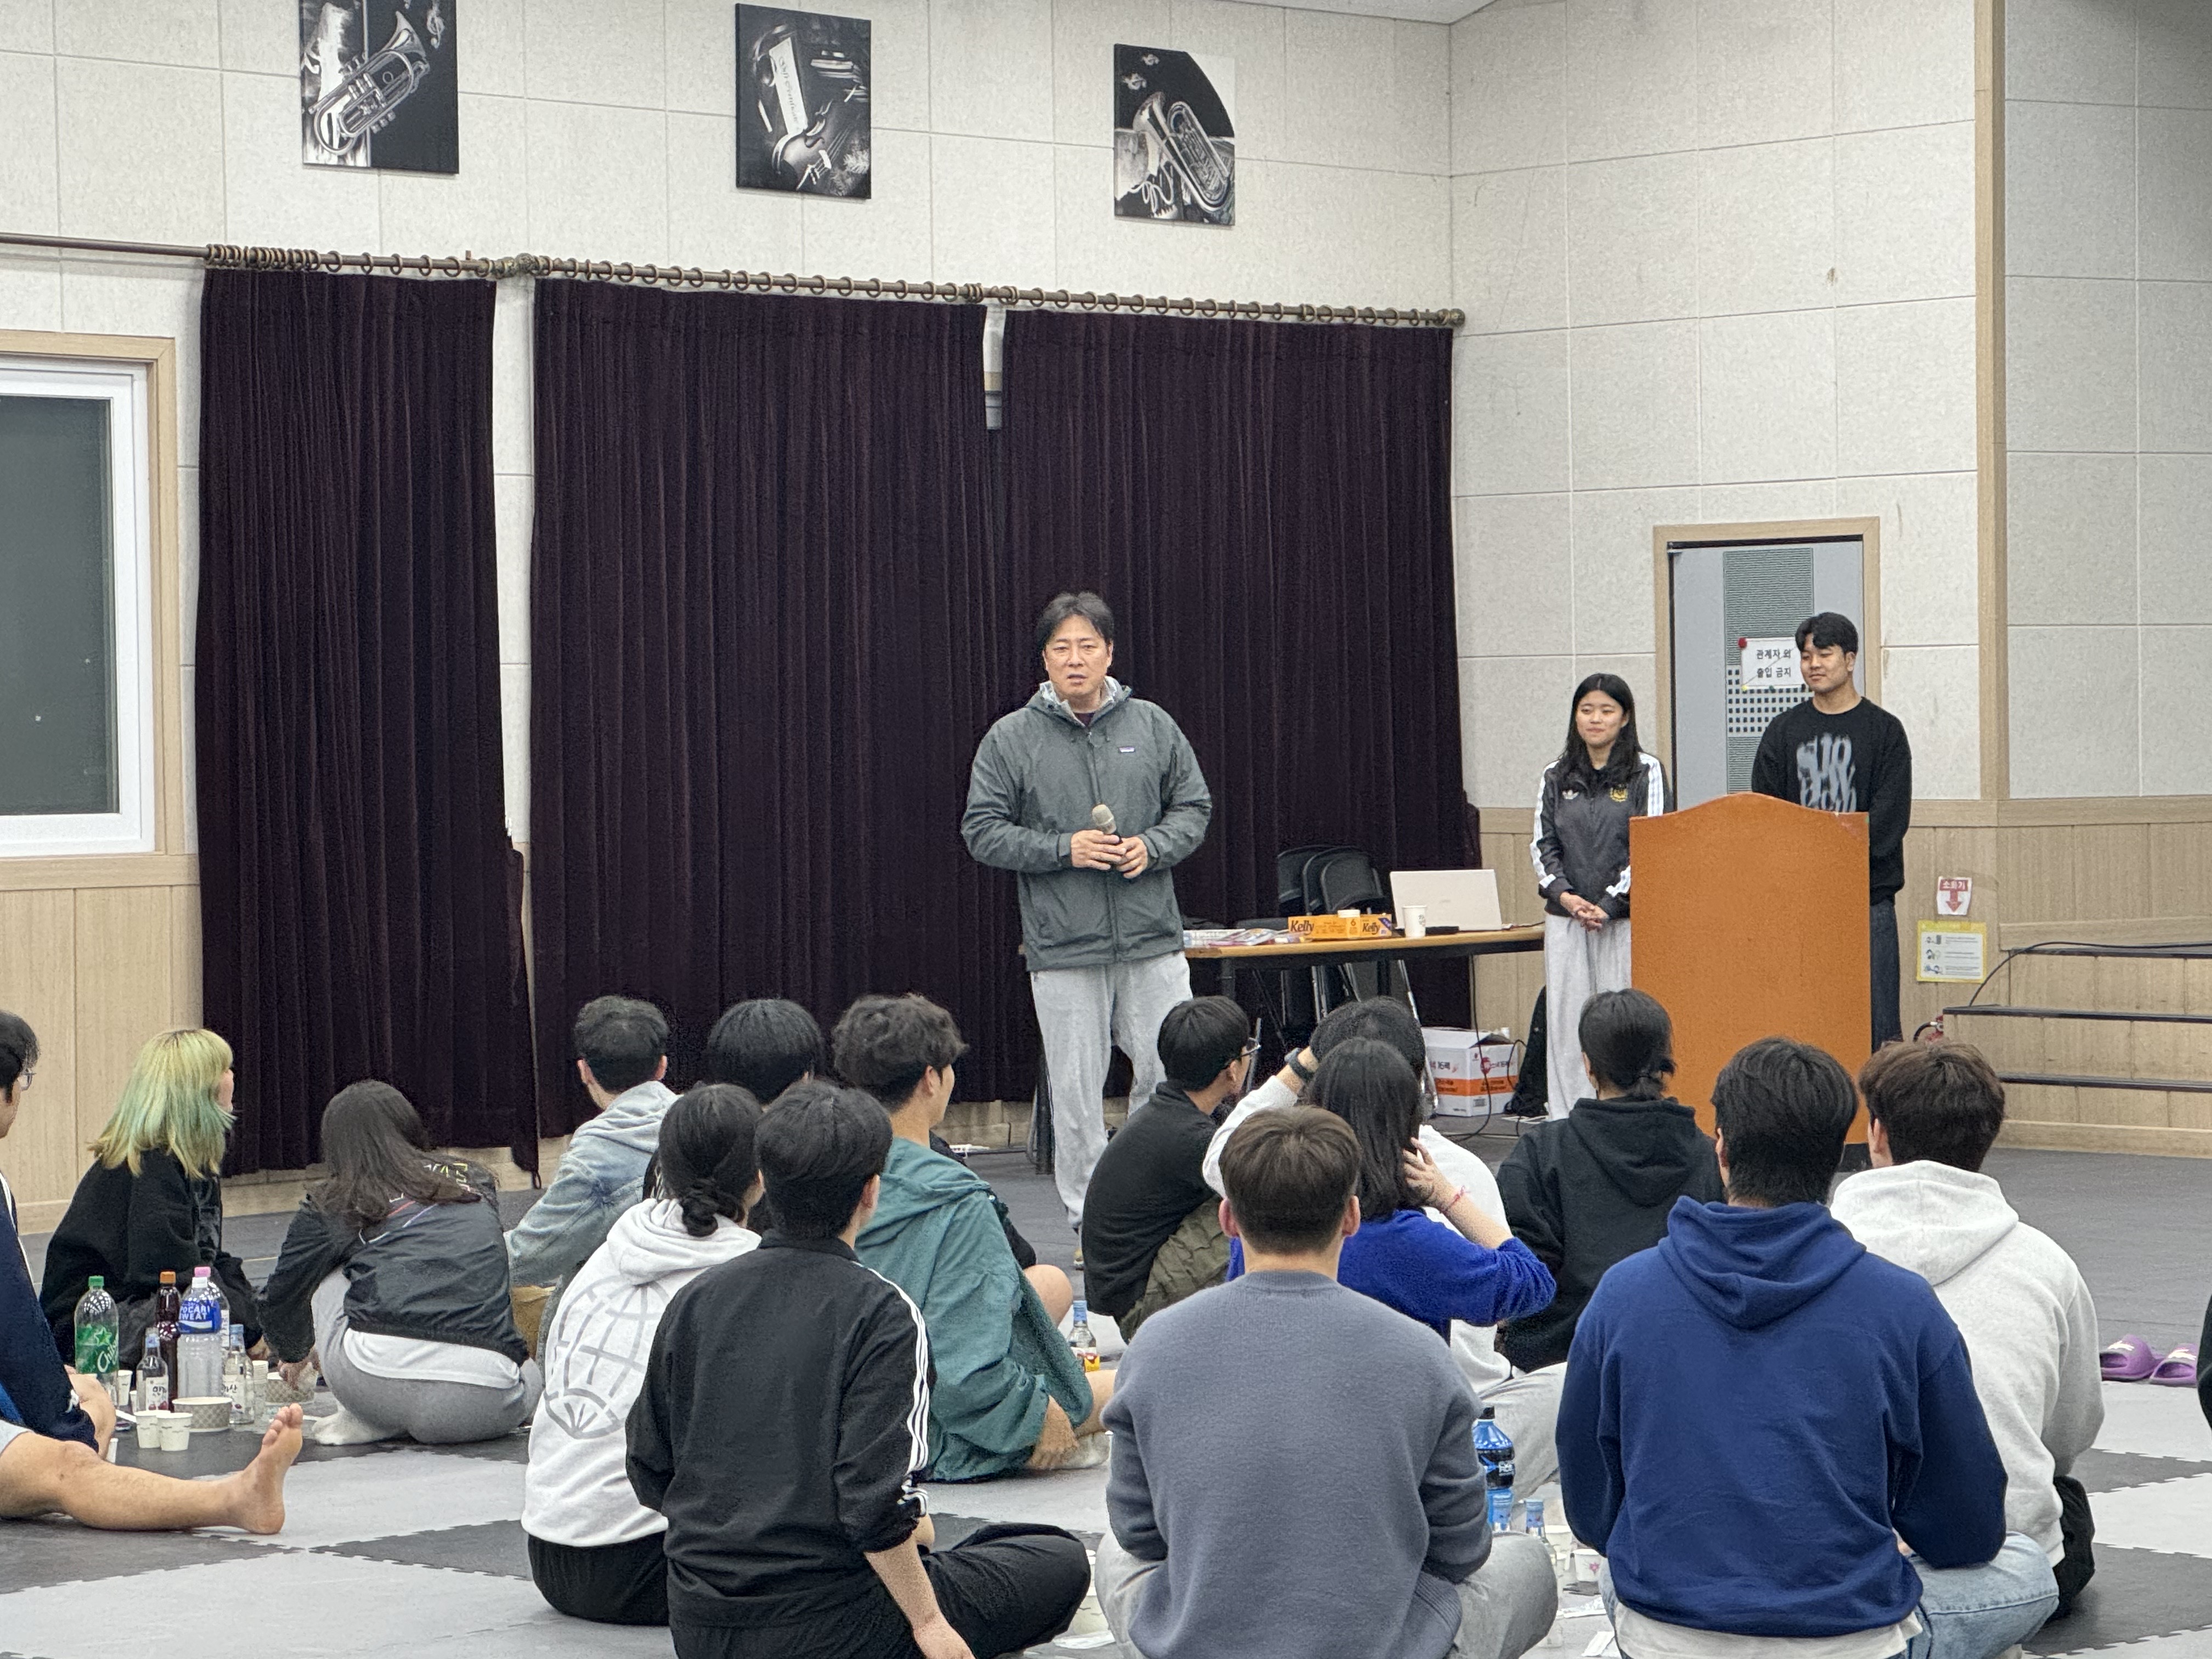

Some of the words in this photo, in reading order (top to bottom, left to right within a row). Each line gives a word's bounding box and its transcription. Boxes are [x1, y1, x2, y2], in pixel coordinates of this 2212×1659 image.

[1784, 649, 1791, 659] 외
[1757, 667, 1772, 678] 출입
[1776, 667, 1791, 678] 금지
[1290, 919, 1314, 935] Kelly
[1362, 922, 1380, 935] Kelly
